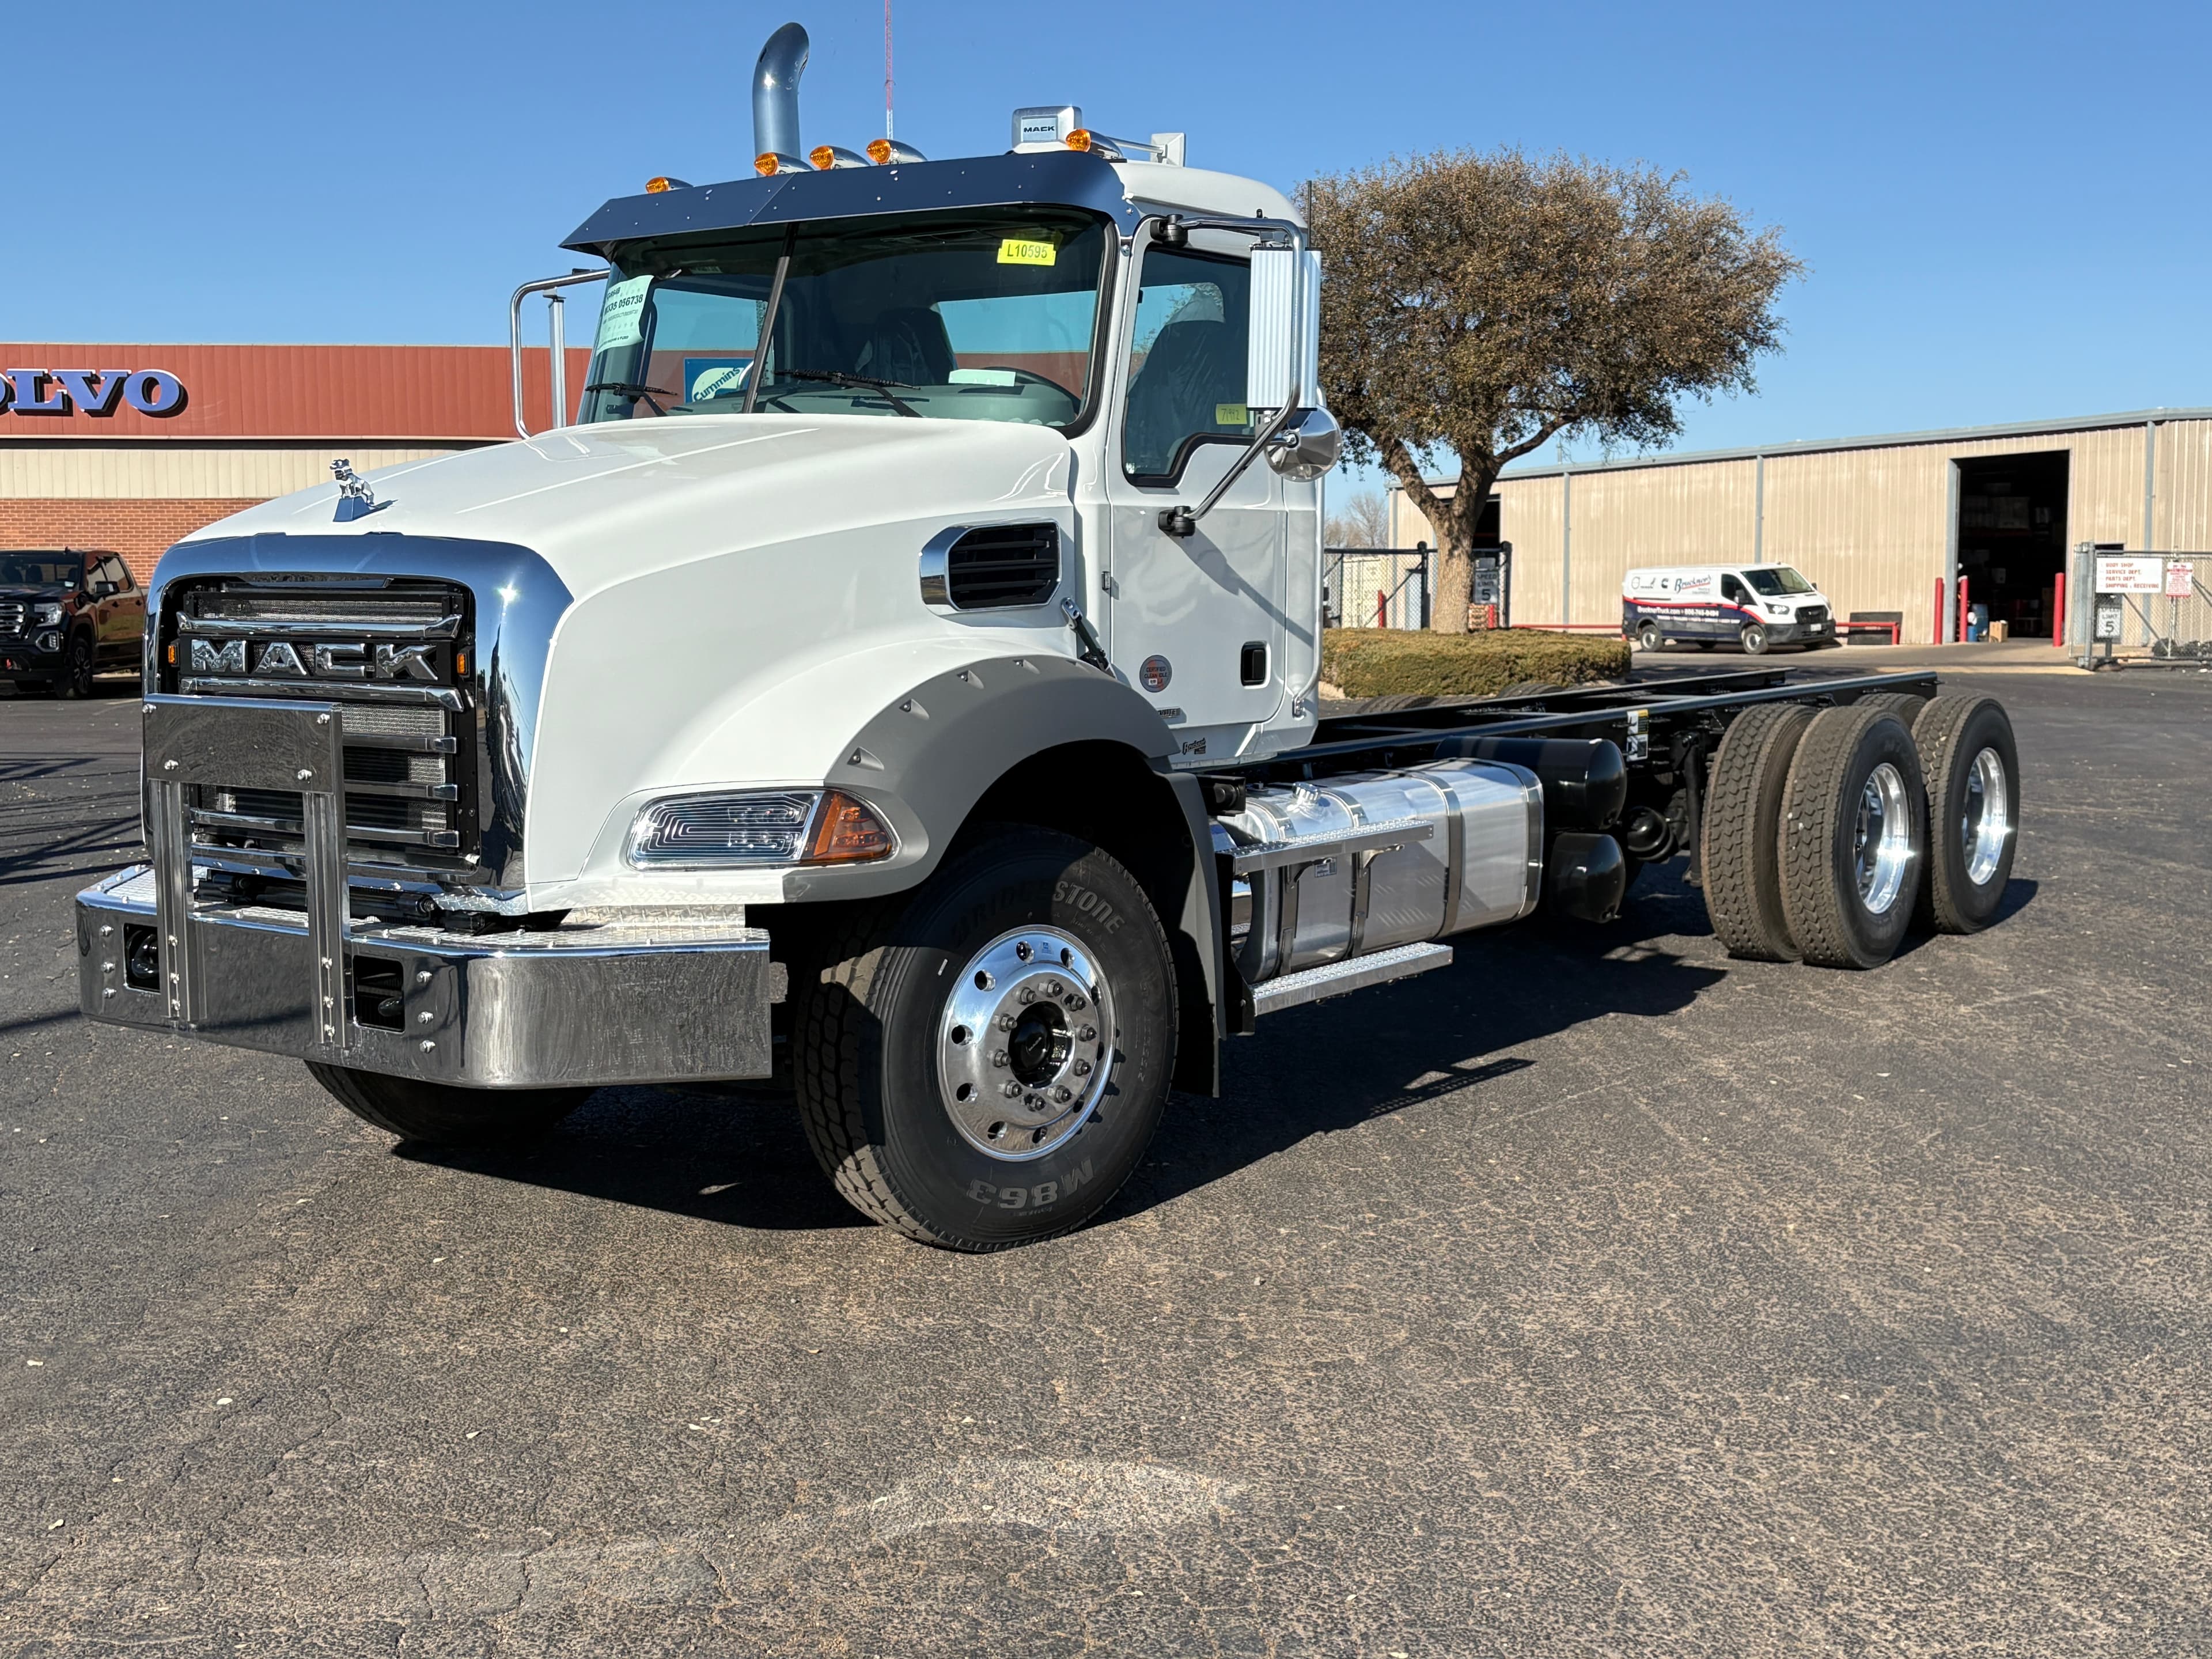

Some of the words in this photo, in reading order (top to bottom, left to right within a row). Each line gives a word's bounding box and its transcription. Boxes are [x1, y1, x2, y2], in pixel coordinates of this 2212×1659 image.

[1007, 244, 1047, 258] L10595
[0, 368, 181, 412] LVO
[694, 366, 740, 401] Cummins
[1482, 589, 1491, 601] 5
[2105, 621, 2115, 632] 5
[191, 639, 438, 681] MACK
[967, 1156, 1094, 1209] M863
